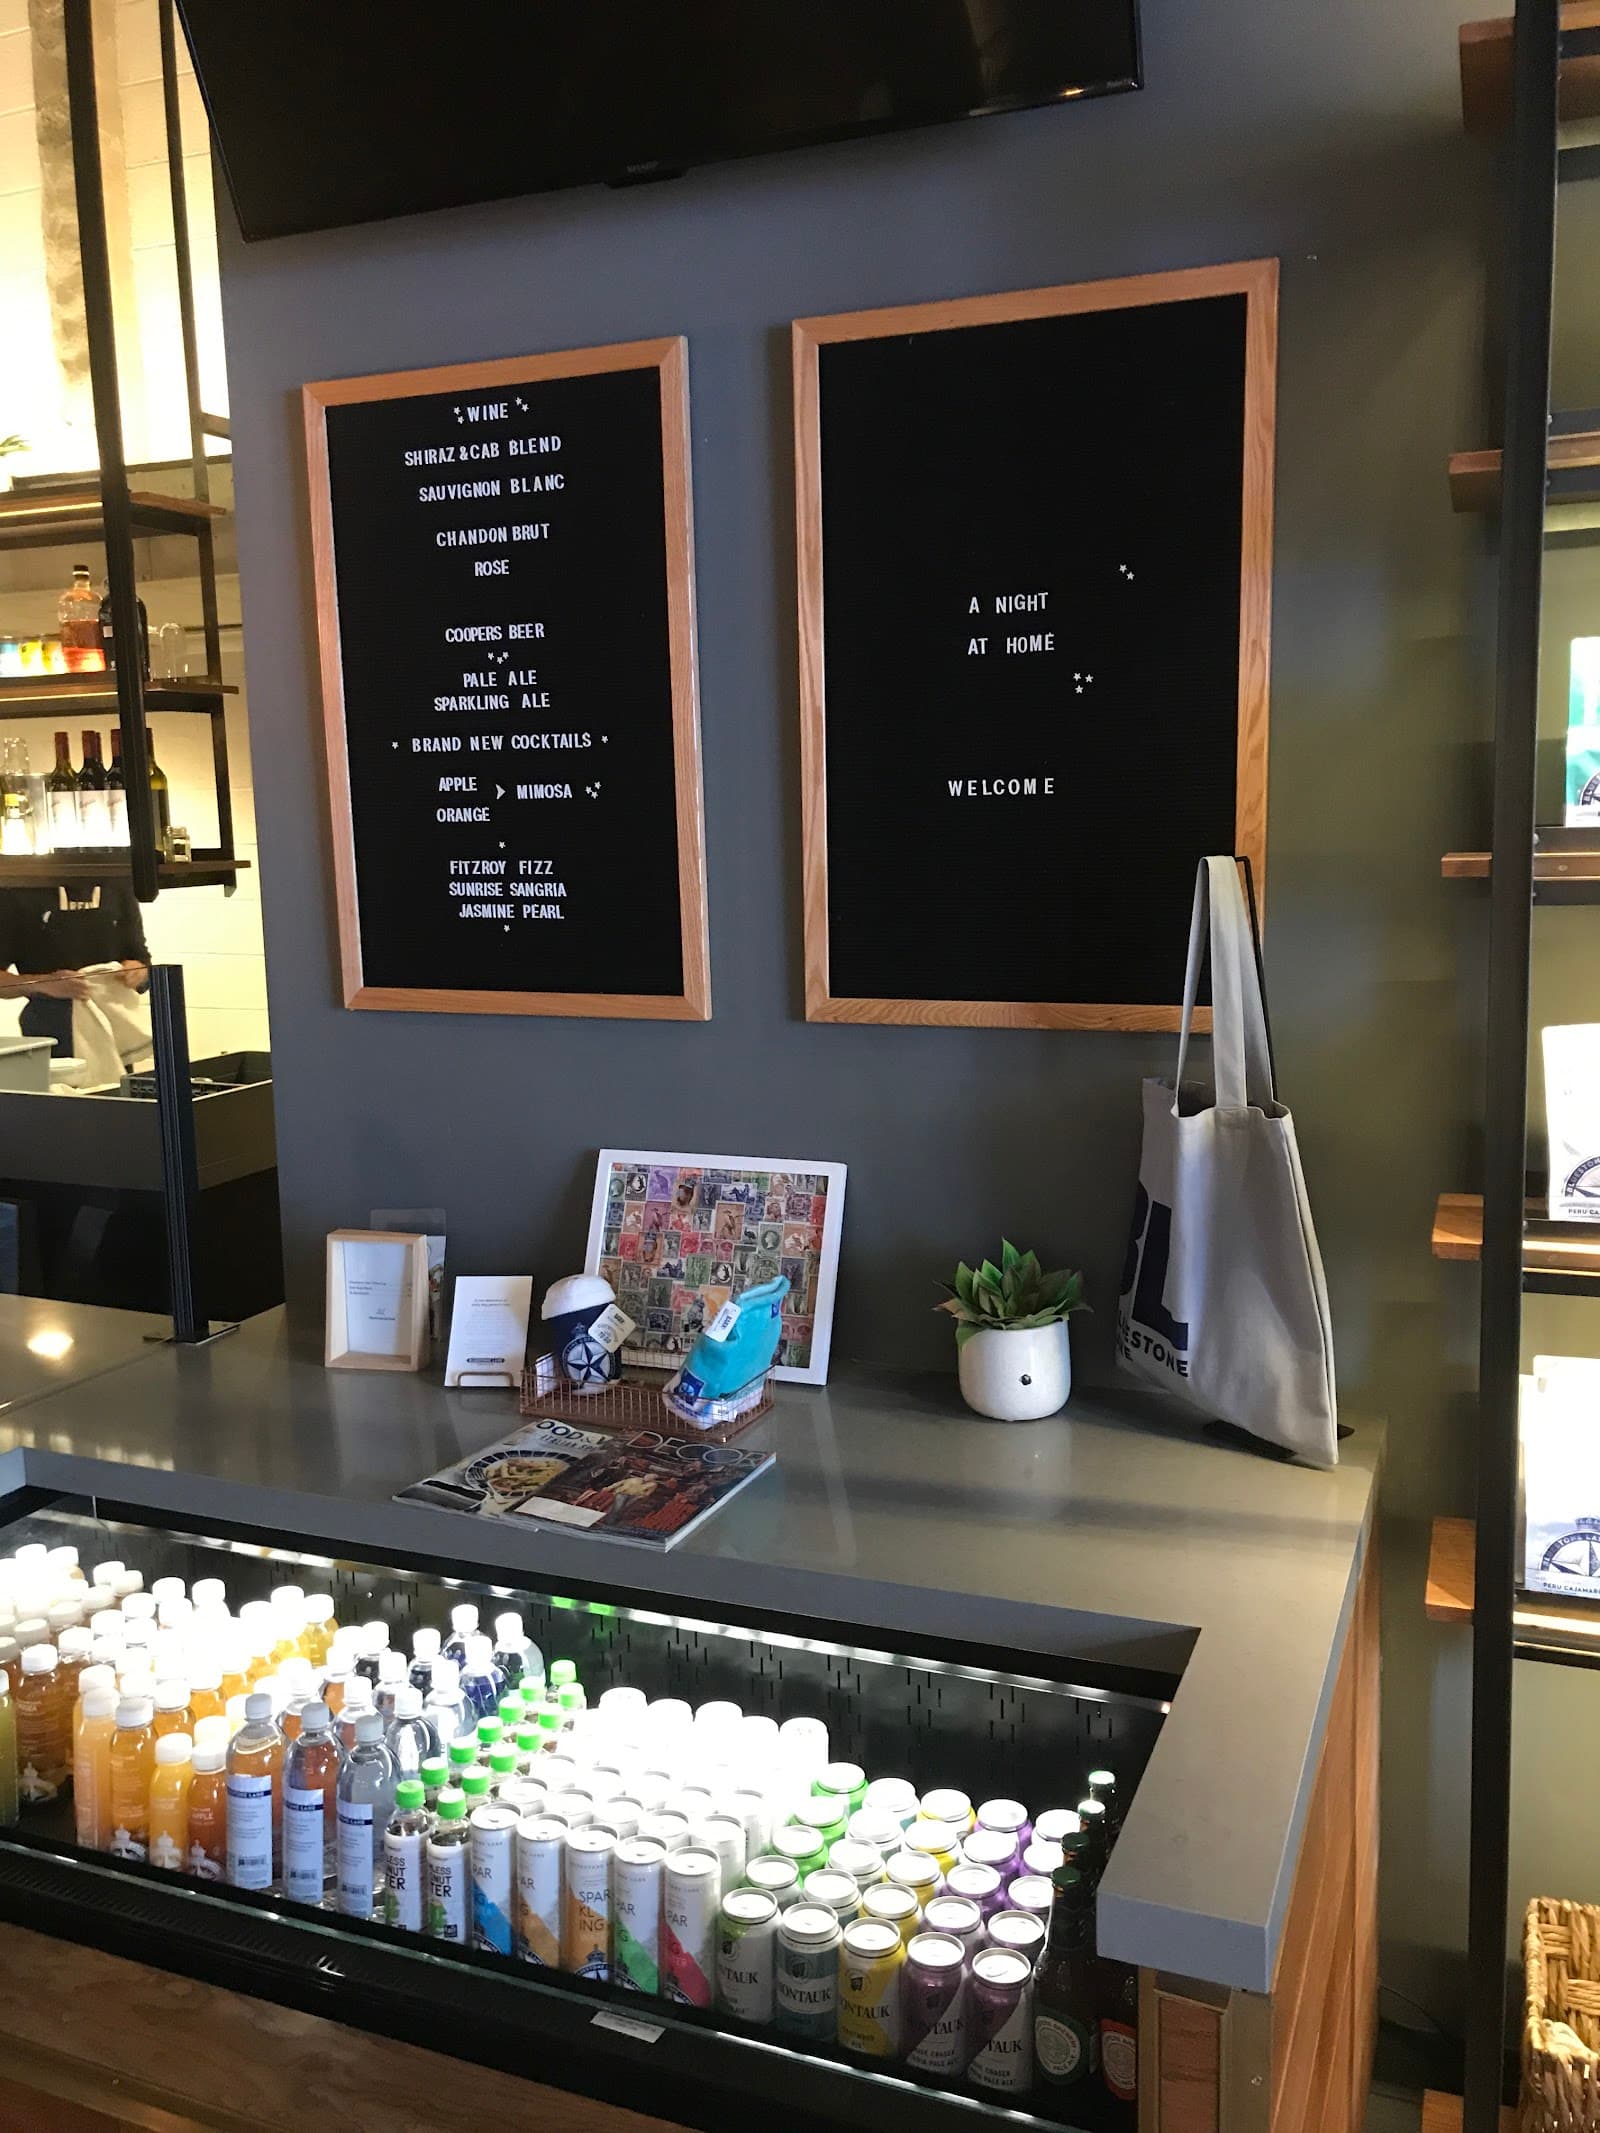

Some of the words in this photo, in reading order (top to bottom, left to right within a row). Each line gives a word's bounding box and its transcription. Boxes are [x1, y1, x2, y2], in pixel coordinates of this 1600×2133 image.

[467, 403, 509, 422] WINE
[404, 447, 456, 466] SHIRAZ
[509, 436, 562, 456] BLEND
[419, 480, 500, 502] SAUVIGNON
[510, 474, 565, 494] BLANC
[436, 527, 507, 547] CHANDON
[512, 523, 550, 542] BRUT
[474, 559, 510, 577] ROSE
[969, 596, 980, 614] A
[995, 592, 1049, 614] NIGHT
[445, 626, 503, 643] COOPERS
[509, 623, 545, 640] BEER
[968, 638, 988, 655] AT
[1006, 632, 1055, 654] HOME
[463, 671, 497, 688] PALE
[508, 670, 538, 686] ALE
[433, 694, 510, 712] SPARKLING
[521, 693, 551, 709] ALE
[412, 736, 462, 753] BRAND
[470, 735, 504, 751] NEW
[511, 732, 592, 750] COCKTAILS
[438, 776, 478, 792] APPLE
[516, 783, 573, 800] MIMOSA
[948, 778, 1055, 797] WELCOME
[436, 807, 491, 823] ORANGE
[450, 860, 506, 875] FITZROY
[519, 860, 553, 875] FIZZ
[449, 882, 504, 897] SUNRISE
[510, 883, 567, 897] SANGRIA
[459, 904, 515, 919] JASMINE
[523, 904, 565, 919] PEARL
